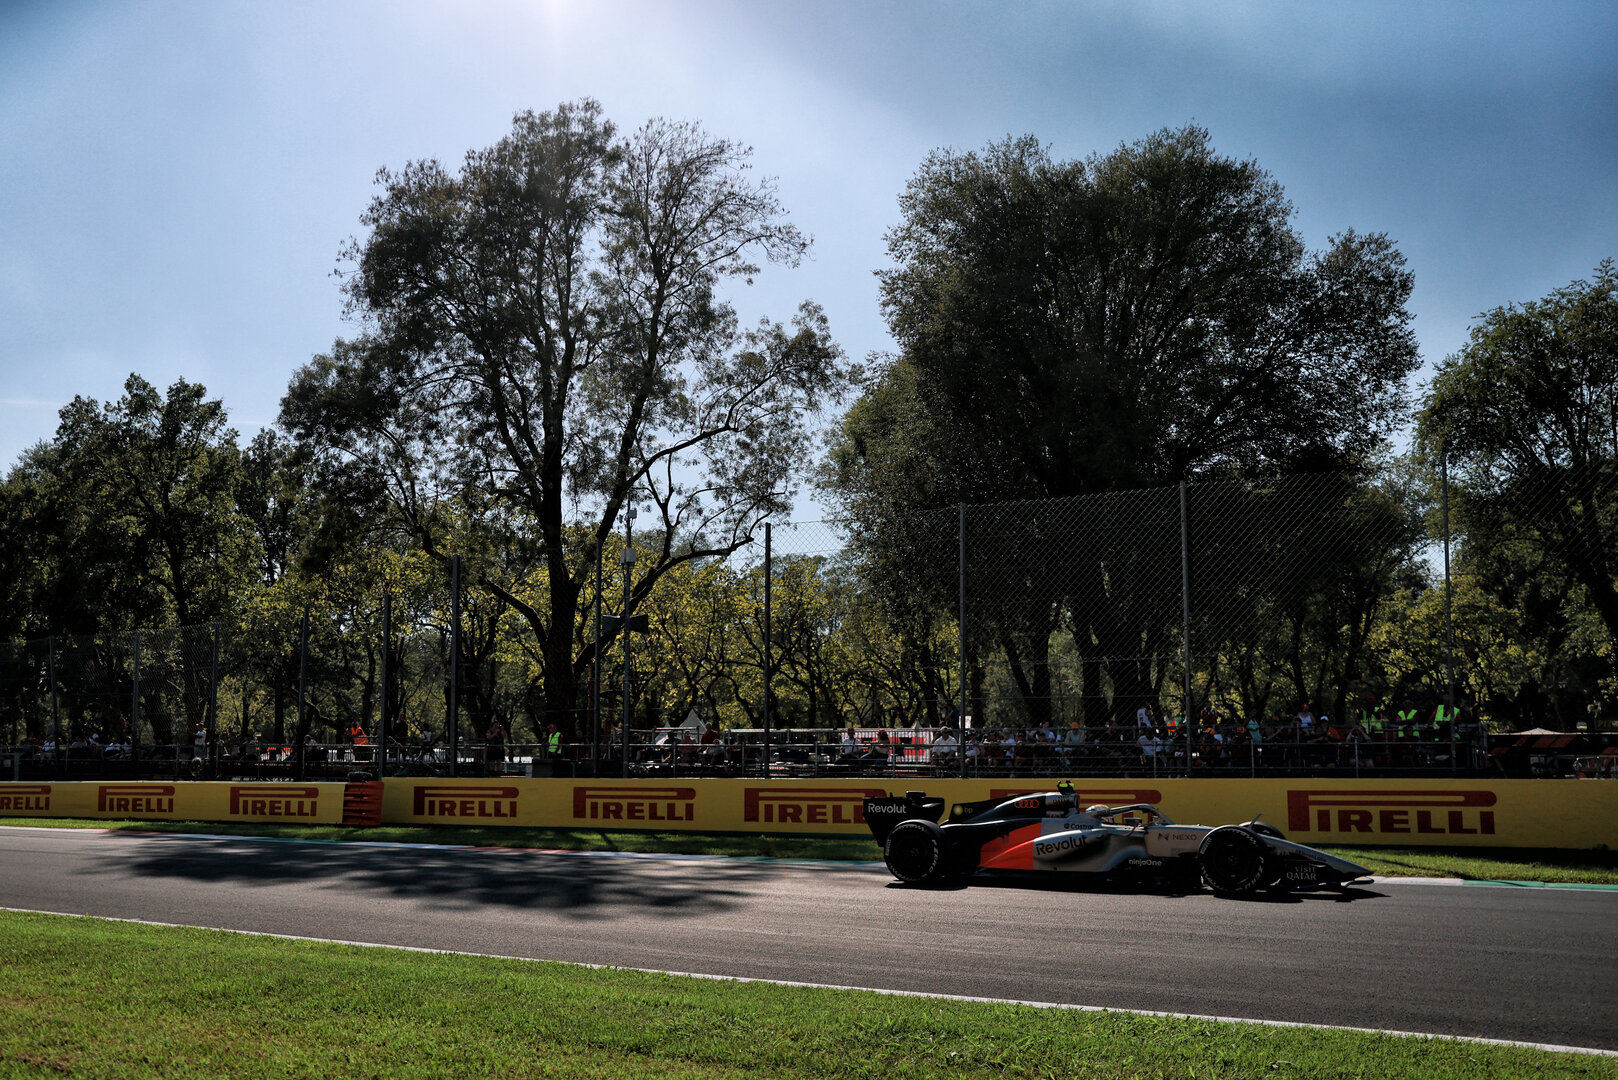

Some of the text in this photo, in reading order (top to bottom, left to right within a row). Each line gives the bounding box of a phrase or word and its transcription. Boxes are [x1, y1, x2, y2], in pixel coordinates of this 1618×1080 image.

[0, 785, 52, 810] RELLI
[98, 785, 175, 813] PIRELLI
[230, 787, 319, 816] PIRELLI
[413, 786, 519, 818] PIRELLI
[573, 787, 696, 821] PIRELLI
[744, 788, 887, 824] PIRELL
[867, 803, 907, 814] Revolut
[1287, 790, 1497, 834] PIRELLI
[1035, 835, 1088, 856] Revolut
[1128, 858, 1162, 867] ninjaOne
[1286, 871, 1317, 881] QATAR
